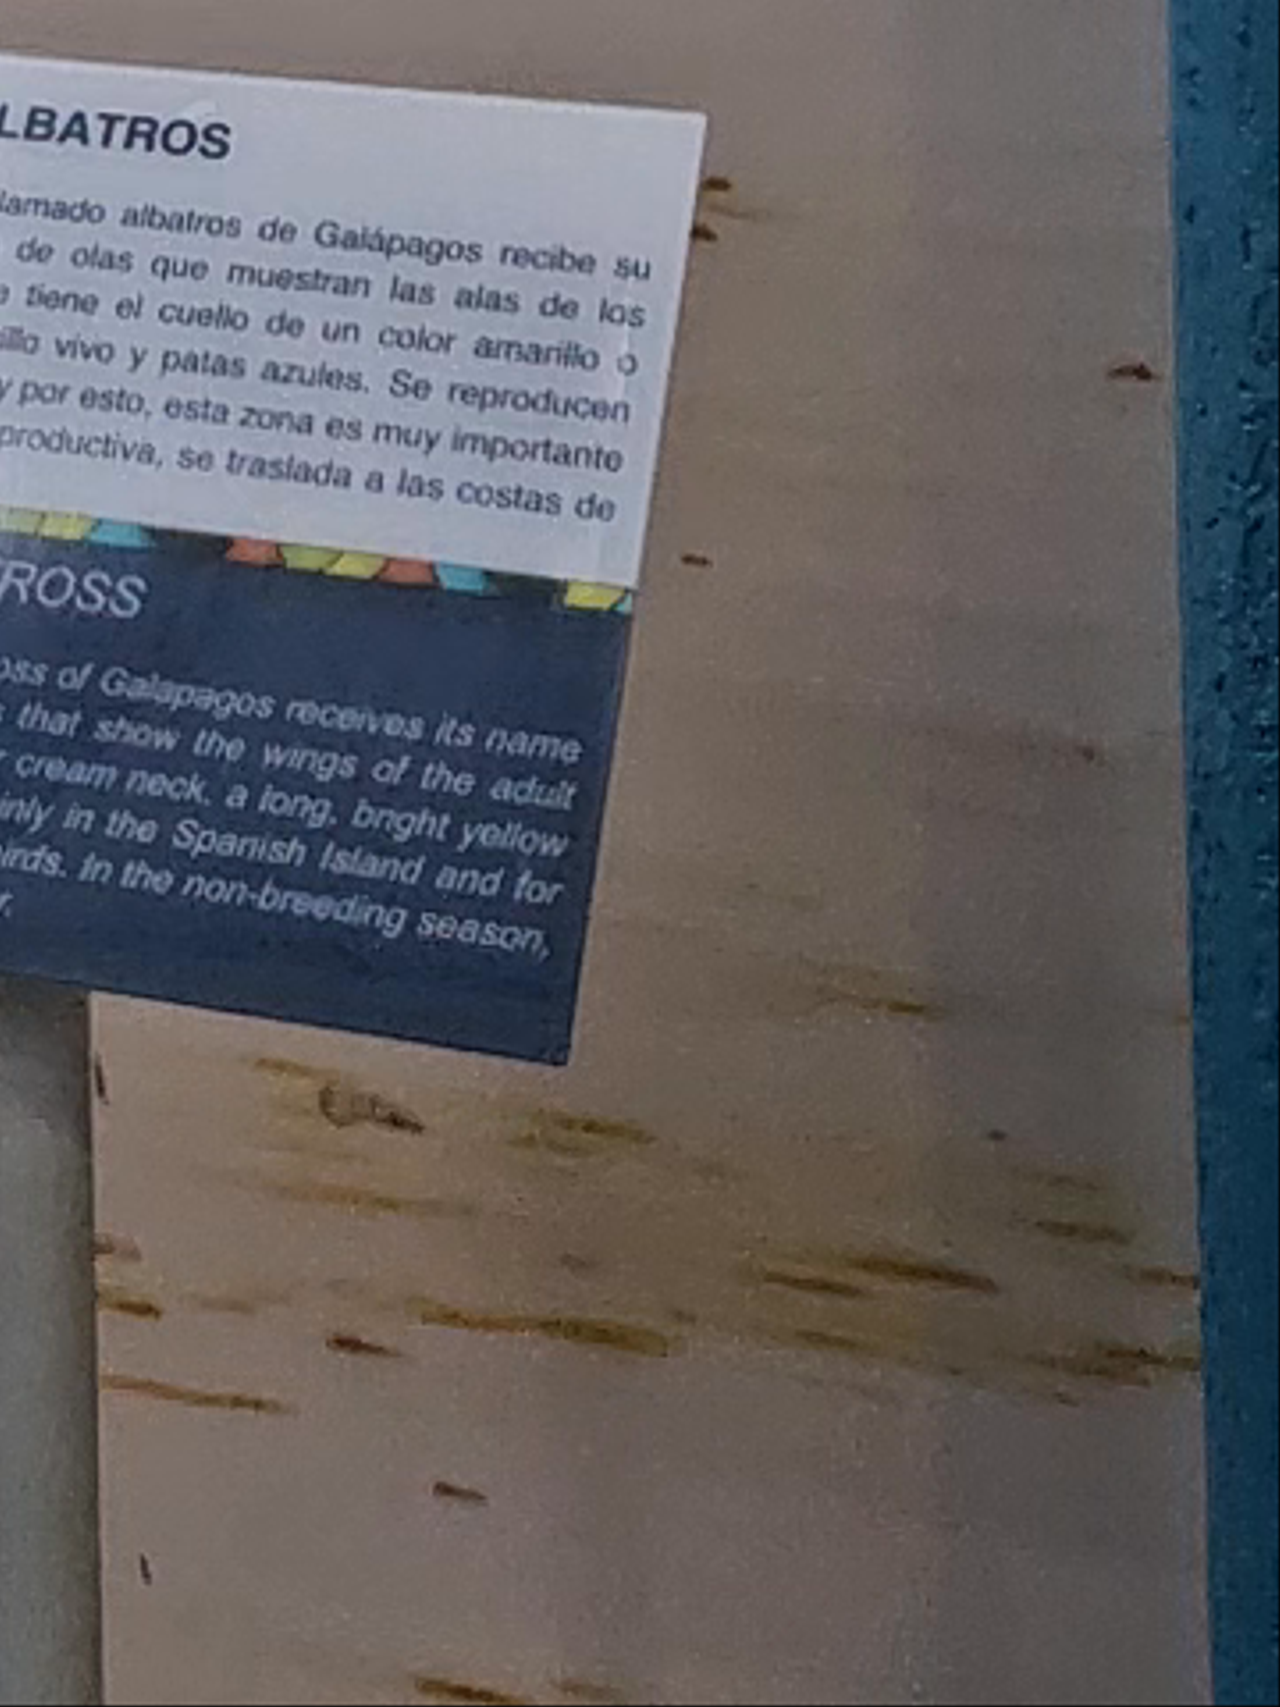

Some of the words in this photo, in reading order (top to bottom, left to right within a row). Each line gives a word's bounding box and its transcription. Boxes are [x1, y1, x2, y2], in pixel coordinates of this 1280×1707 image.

[14, 236, 56, 264] de
[69, 242, 134, 274] olas
[150, 254, 210, 283] que
[226, 263, 372, 299] muestran
[388, 274, 436, 306] las
[453, 283, 521, 315] alas
[538, 292, 580, 321] de
[598, 296, 646, 330] los
[119, 203, 242, 239] albatros
[256, 216, 298, 244] de
[313, 219, 483, 267] Galápagos
[499, 244, 598, 276] recibe
[612, 256, 652, 282] su
[25, 283, 100, 317] tiene
[114, 292, 145, 320] el
[157, 302, 250, 333] cuello
[264, 309, 306, 340] de
[320, 321, 361, 344] un
[377, 323, 458, 355] color
[472, 335, 601, 372] amarillo
[616, 352, 640, 378] o
[54, 332, 116, 366] vivo
[127, 345, 149, 374] y
[159, 349, 247, 379] patas
[388, 368, 433, 402] Se
[446, 382, 631, 426] reproducen
[16, 379, 72, 408] por
[162, 397, 231, 425] esta
[237, 406, 315, 436] zona
[324, 416, 363, 442] es
[371, 422, 442, 457] muy
[450, 425, 625, 474] importante
[176, 445, 215, 473] se
[224, 448, 353, 490] traslada
[363, 470, 385, 494] a
[395, 467, 445, 502] las
[455, 480, 563, 517] costas
[573, 492, 617, 523] de
